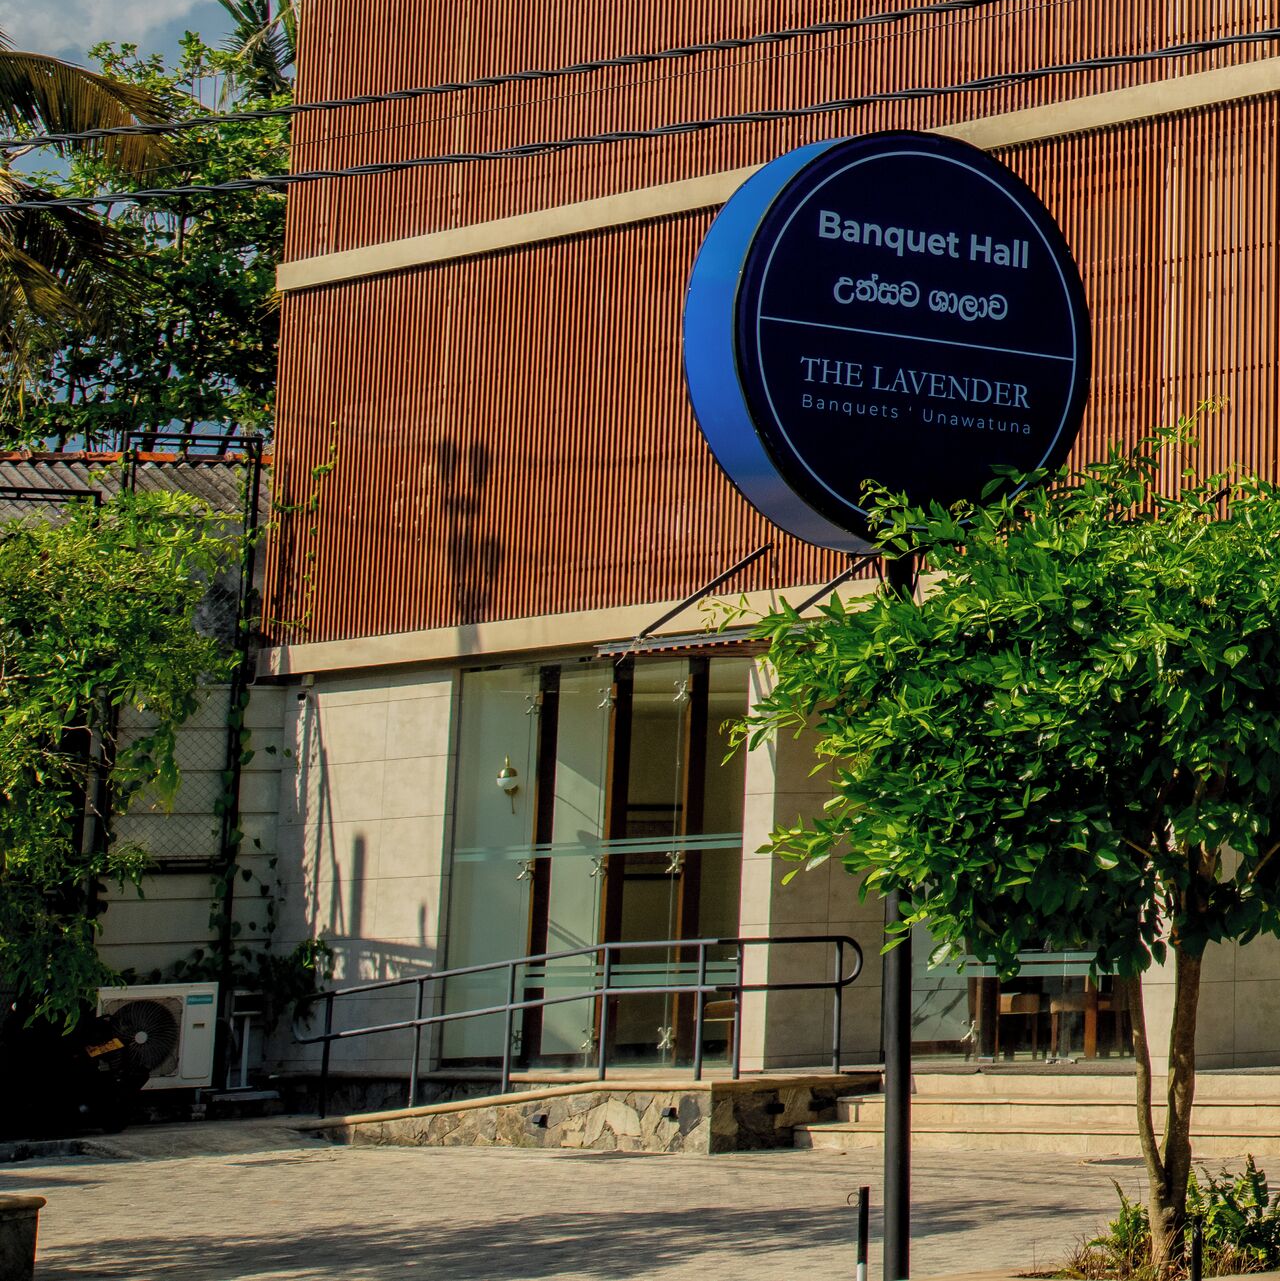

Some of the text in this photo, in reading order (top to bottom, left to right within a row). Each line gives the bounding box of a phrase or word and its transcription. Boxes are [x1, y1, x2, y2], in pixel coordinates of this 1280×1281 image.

[819, 210, 1029, 269] Banquet Hall
[834, 274, 1008, 322] උත්සව ශාලාව
[800, 356, 1031, 409] THE LAVENDER
[803, 394, 1031, 434] Banquets Unawatuna
